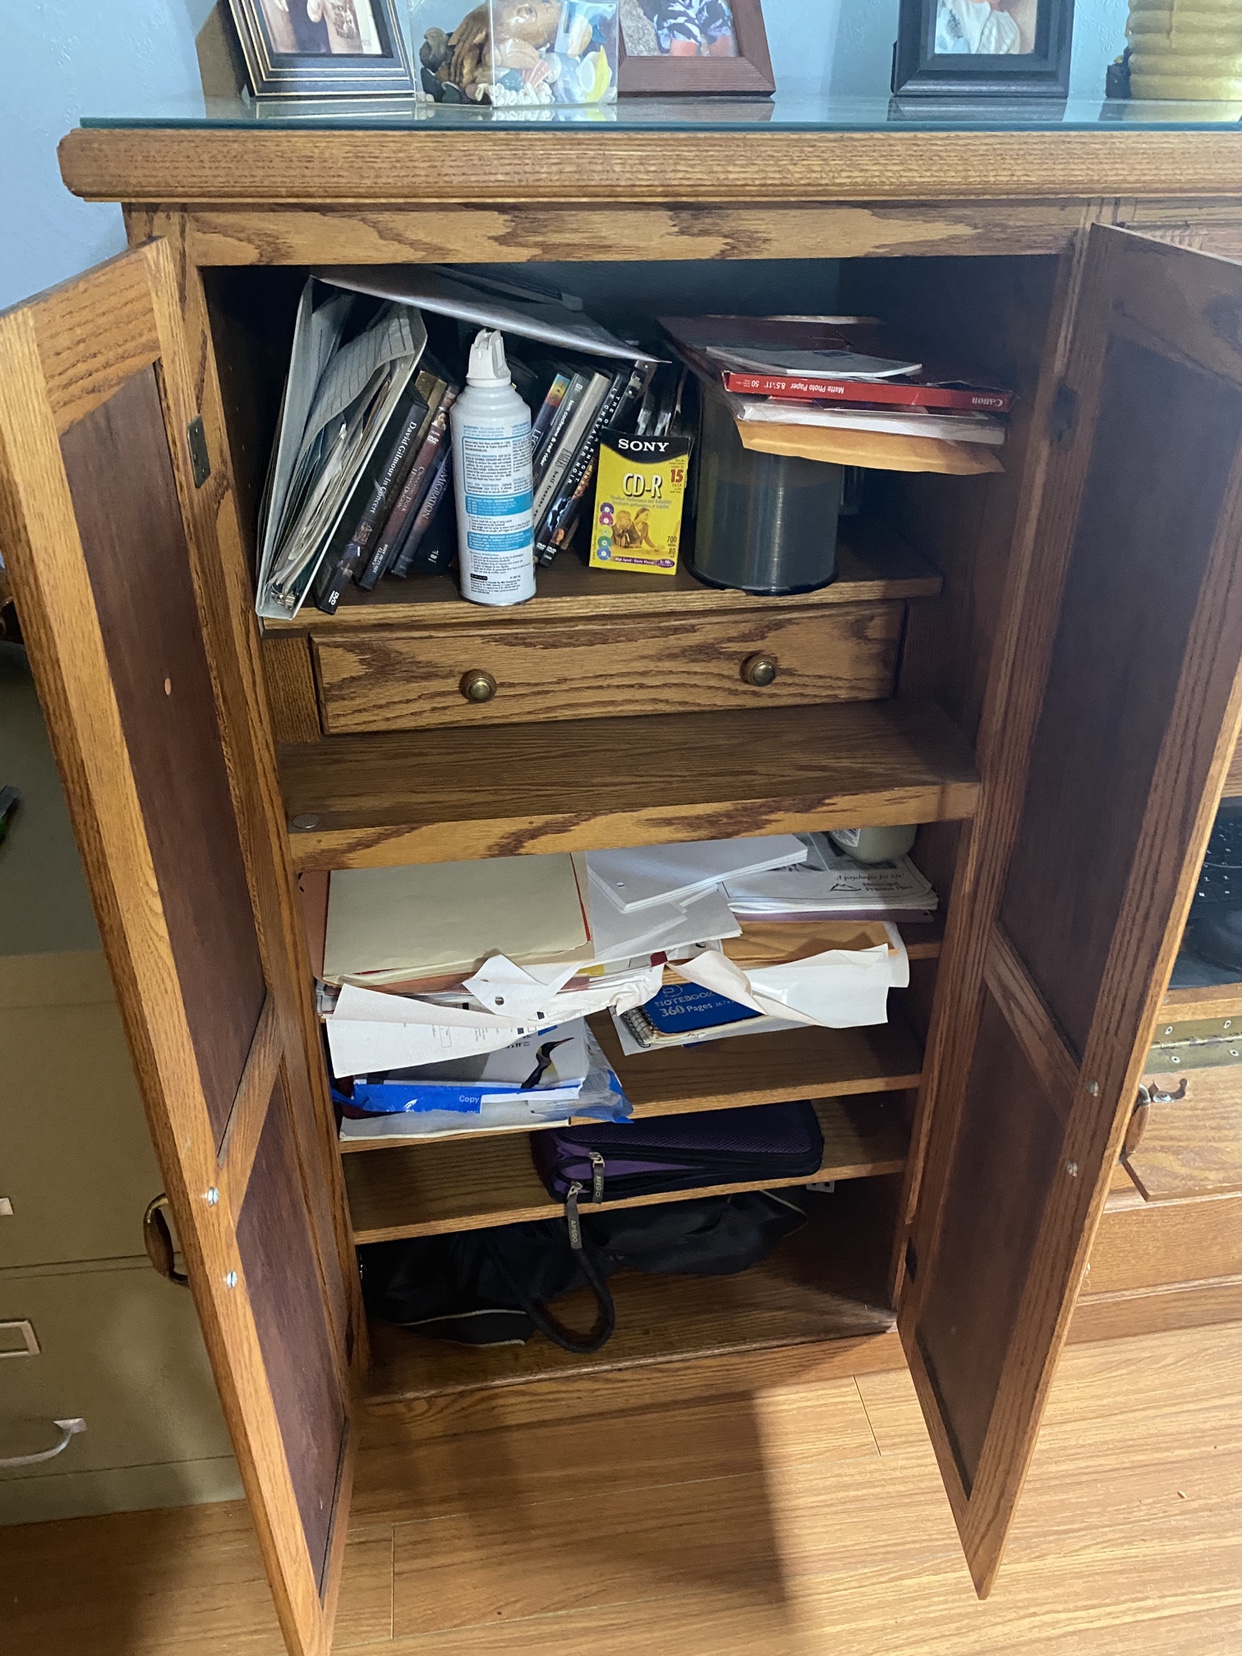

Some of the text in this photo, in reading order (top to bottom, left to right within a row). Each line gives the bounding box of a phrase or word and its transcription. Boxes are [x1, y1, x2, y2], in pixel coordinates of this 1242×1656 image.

[790, 383, 808, 391] Paper
[809, 384, 826, 393] Photo
[827, 386, 845, 394] Matte
[566, 400, 575, 411] tom
[609, 396, 620, 413] THE
[971, 397, 1003, 407] Canon
[554, 411, 568, 437] cochrane
[581, 404, 609, 457] CHEVALIER
[618, 438, 669, 452] SONY
[540, 452, 548, 466] rider
[575, 448, 594, 482] KNIGHT
[370, 421, 417, 513] David Gilmour In Concert
[567, 461, 581, 484] NOIR
[550, 470, 559, 484] hell
[671, 469, 683, 483] 15
[622, 473, 662, 498] CD-R
[422, 474, 448, 519] MIGRATION
[329, 590, 340, 605] DVD
[654, 991, 715, 1007] NOTEBOOK
[659, 1005, 685, 1017] 360
[686, 1003, 713, 1013] Pages
[459, 1095, 480, 1104] Copy
